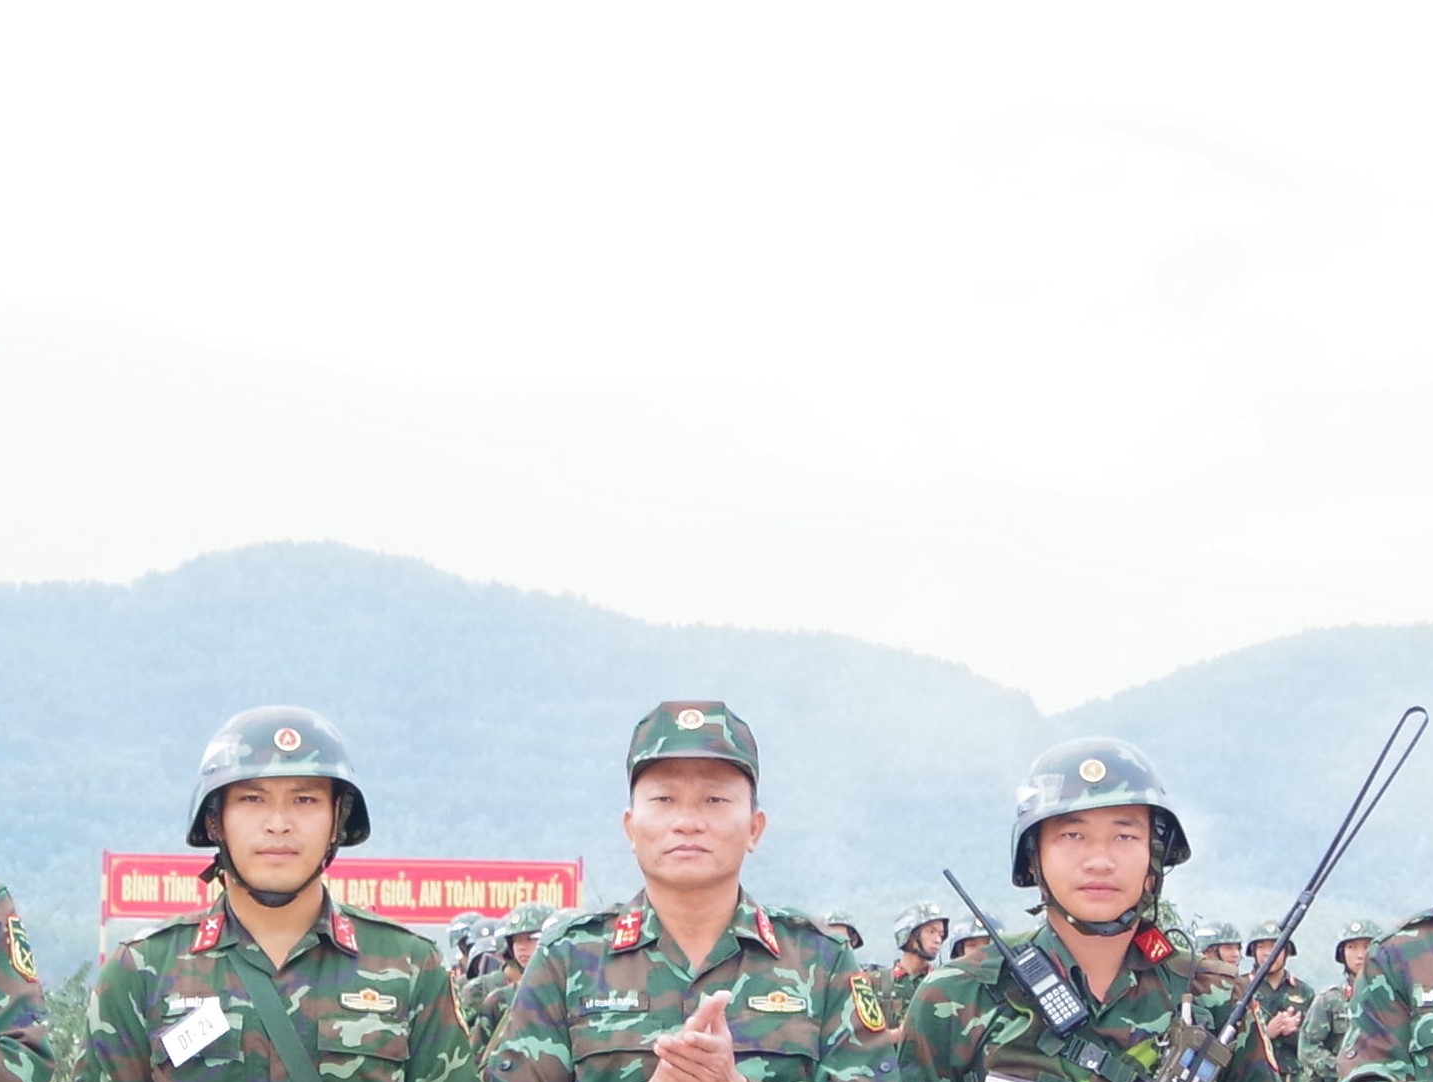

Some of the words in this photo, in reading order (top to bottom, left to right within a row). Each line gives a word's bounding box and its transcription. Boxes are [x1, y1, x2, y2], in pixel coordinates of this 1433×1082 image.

[122, 869, 159, 902] BÌNH
[162, 870, 202, 906] TĨNH,
[347, 878, 377, 910] ĐẠT
[380, 871, 416, 910] GIỎI,
[419, 880, 442, 907] AN
[445, 875, 485, 908] TOÀN
